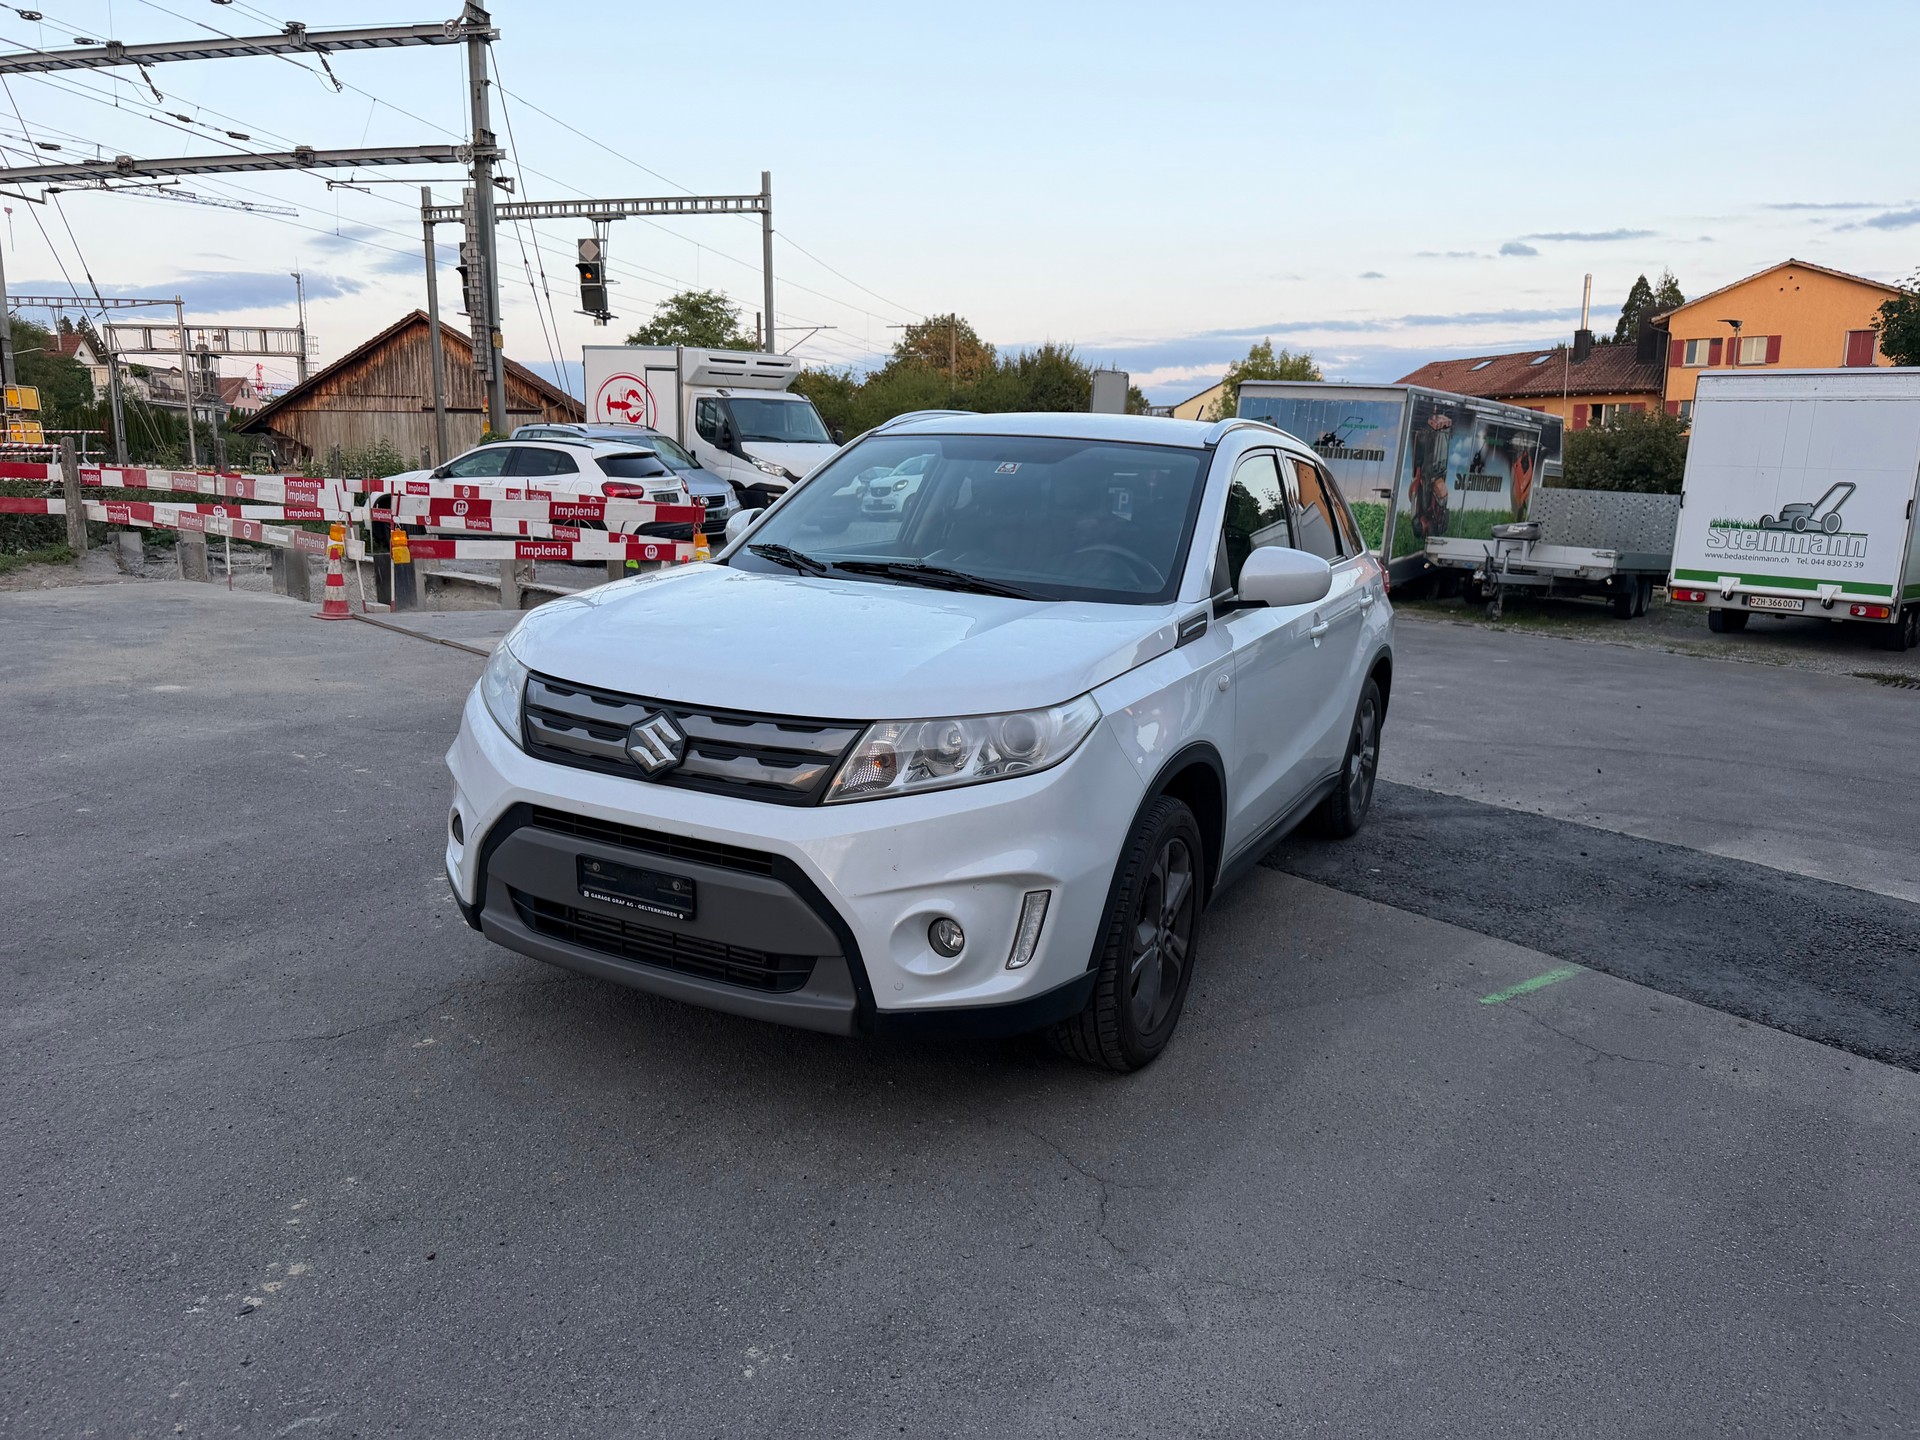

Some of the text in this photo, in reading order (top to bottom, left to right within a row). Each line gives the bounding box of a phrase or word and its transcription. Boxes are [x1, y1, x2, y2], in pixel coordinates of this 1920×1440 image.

[81, 472, 100, 484] Implenia
[174, 476, 196, 488] Implenia
[287, 479, 321, 488] Implenia
[407, 484, 428, 493] Implenia
[287, 489, 315, 503] Implenia
[108, 510, 128, 522] Implenia
[287, 508, 321, 519] Implenia
[372, 510, 391, 520] Implenia
[554, 505, 600, 517] Implenia
[180, 514, 202, 527] Implenia
[466, 518, 490, 529] Implenia
[554, 528, 578, 539] Implenia
[296, 535, 325, 549] Implenia
[1706, 527, 1868, 558] Steinmann
[520, 544, 567, 556] Implenia
[1704, 551, 1865, 569] www.bedasteinmann.ch Tel. 044 830 25 39
[590, 892, 611, 903] GARAGE
[612, 898, 625, 906] GRAF
[638, 904, 678, 918] GELTERKINDEN
